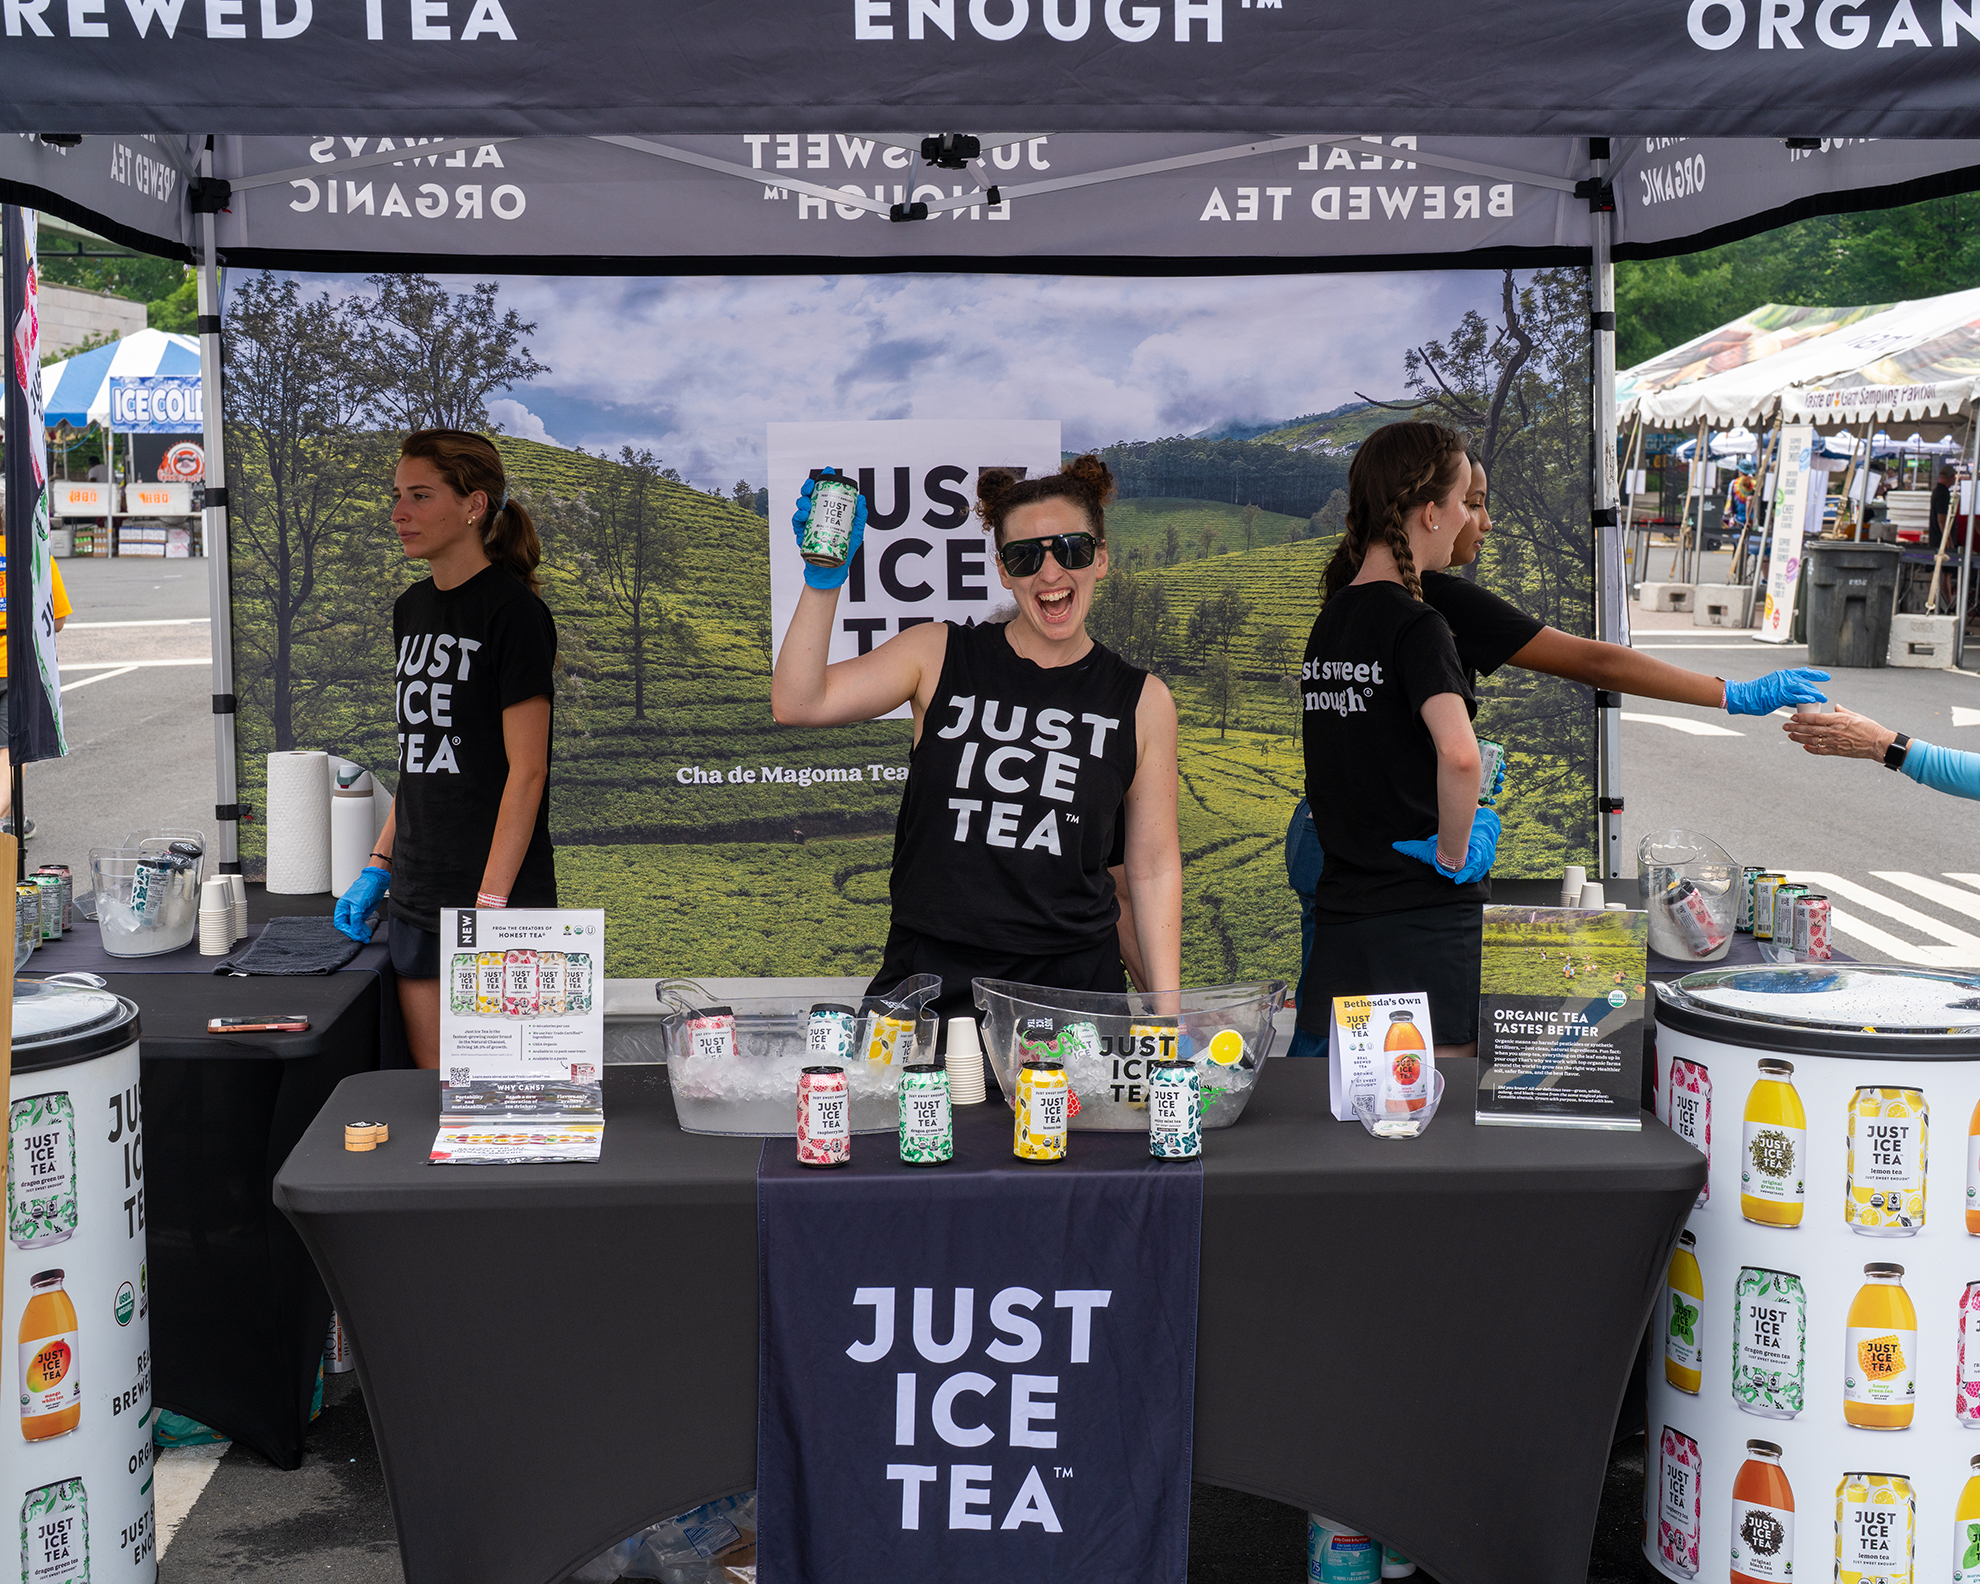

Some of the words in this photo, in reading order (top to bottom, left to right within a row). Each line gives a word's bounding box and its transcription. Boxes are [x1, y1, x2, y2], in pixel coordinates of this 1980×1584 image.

[366, 0, 517, 41] TEA
[1859, 386, 1899, 407] Sampling
[113, 387, 150, 423] ICE
[822, 500, 848, 511] JUST
[826, 508, 843, 518] ICE
[825, 516, 842, 526] TEA
[848, 538, 988, 603] ICE
[1323, 660, 1384, 685] sweet
[1304, 687, 1374, 718] nough®
[937, 695, 1119, 758] JUST
[676, 766, 723, 784] Cha
[728, 766, 756, 784] de
[761, 766, 863, 788] Magoma
[867, 763, 909, 782] Tea
[956, 742, 1080, 803] ICE
[462, 915, 473, 944] NEW
[1398, 997, 1421, 1005] Own
[1346, 1014, 1370, 1023] JUST
[1493, 1009, 1559, 1022] ORGANIC
[1562, 1012, 1589, 1024] TEA
[809, 1028, 832, 1036] JUST
[1351, 1022, 1367, 1030] ICE
[1493, 1022, 1544, 1035] TASTES
[1547, 1024, 1599, 1037] BETTER
[700, 1037, 725, 1047] JUST
[811, 1035, 827, 1043] ICE
[704, 1045, 722, 1054] ICE
[1099, 1035, 1176, 1057] JUST
[1112, 1060, 1151, 1080] IC
[1110, 1084, 1151, 1103] TE
[1155, 1091, 1180, 1100] JUST
[818, 1101, 844, 1111] JUST
[914, 1100, 941, 1109] JUST
[1040, 1096, 1065, 1107] JUST
[1158, 1100, 1175, 1108] ICE
[1676, 1095, 1699, 1113] JUST
[822, 1110, 840, 1119] ICE
[918, 1109, 937, 1118] ICE
[1045, 1106, 1061, 1115] ICE
[1158, 1109, 1176, 1117] TEA
[1679, 1109, 1695, 1125] ICE
[822, 1119, 841, 1128] TEA
[918, 1119, 938, 1127] TEA
[1044, 1115, 1062, 1123] TEA
[1679, 1122, 1695, 1138] TEA
[1867, 1125, 1909, 1139] JUST
[24, 1132, 60, 1151] JUST
[1759, 1138, 1787, 1150] JUST
[1873, 1139, 1901, 1152] ICE
[31, 1146, 55, 1163] ICE
[1763, 1148, 1782, 1159] ICE
[1763, 1158, 1783, 1168] TEA
[20, 1179, 40, 1188] dragon
[41, 1176, 57, 1185] green
[1762, 1179, 1783, 1187] original
[118, 1290, 131, 1305] USDA
[117, 1302, 133, 1317] ORGANIC
[1674, 1304, 1692, 1318] JUST
[1749, 1306, 1787, 1323] JUST
[845, 1286, 1113, 1364] JUST
[1677, 1315, 1689, 1327] ICE
[1755, 1320, 1780, 1335] ICE
[1744, 1346, 1762, 1355] dragon
[1763, 1351, 1781, 1359] green
[1867, 1343, 1897, 1353] JUST
[38, 1349, 64, 1364] JUST
[1872, 1353, 1892, 1363] ICE
[43, 1359, 61, 1372] ICE
[1871, 1363, 1892, 1372] TEA
[43, 1369, 62, 1381] TEA
[44, 1391, 61, 1399] mango
[895, 1371, 1059, 1449] ICE
[1666, 1464, 1689, 1485] JUST
[1669, 1478, 1685, 1496] ICE
[1669, 1491, 1685, 1509] TEA
[1748, 1517, 1777, 1532] JUST
[1854, 1511, 1896, 1525] JUST
[38, 1517, 74, 1539] JUST
[1752, 1527, 1772, 1540] ICE
[1861, 1524, 1889, 1537] ICE
[44, 1532, 68, 1550] ICE
[1752, 1537, 1772, 1549] TEA
[34, 1565, 54, 1576] dragon
[54, 1560, 70, 1572] green
[1749, 1561, 1764, 1569] black
[1751, 1557, 1772, 1566] original
